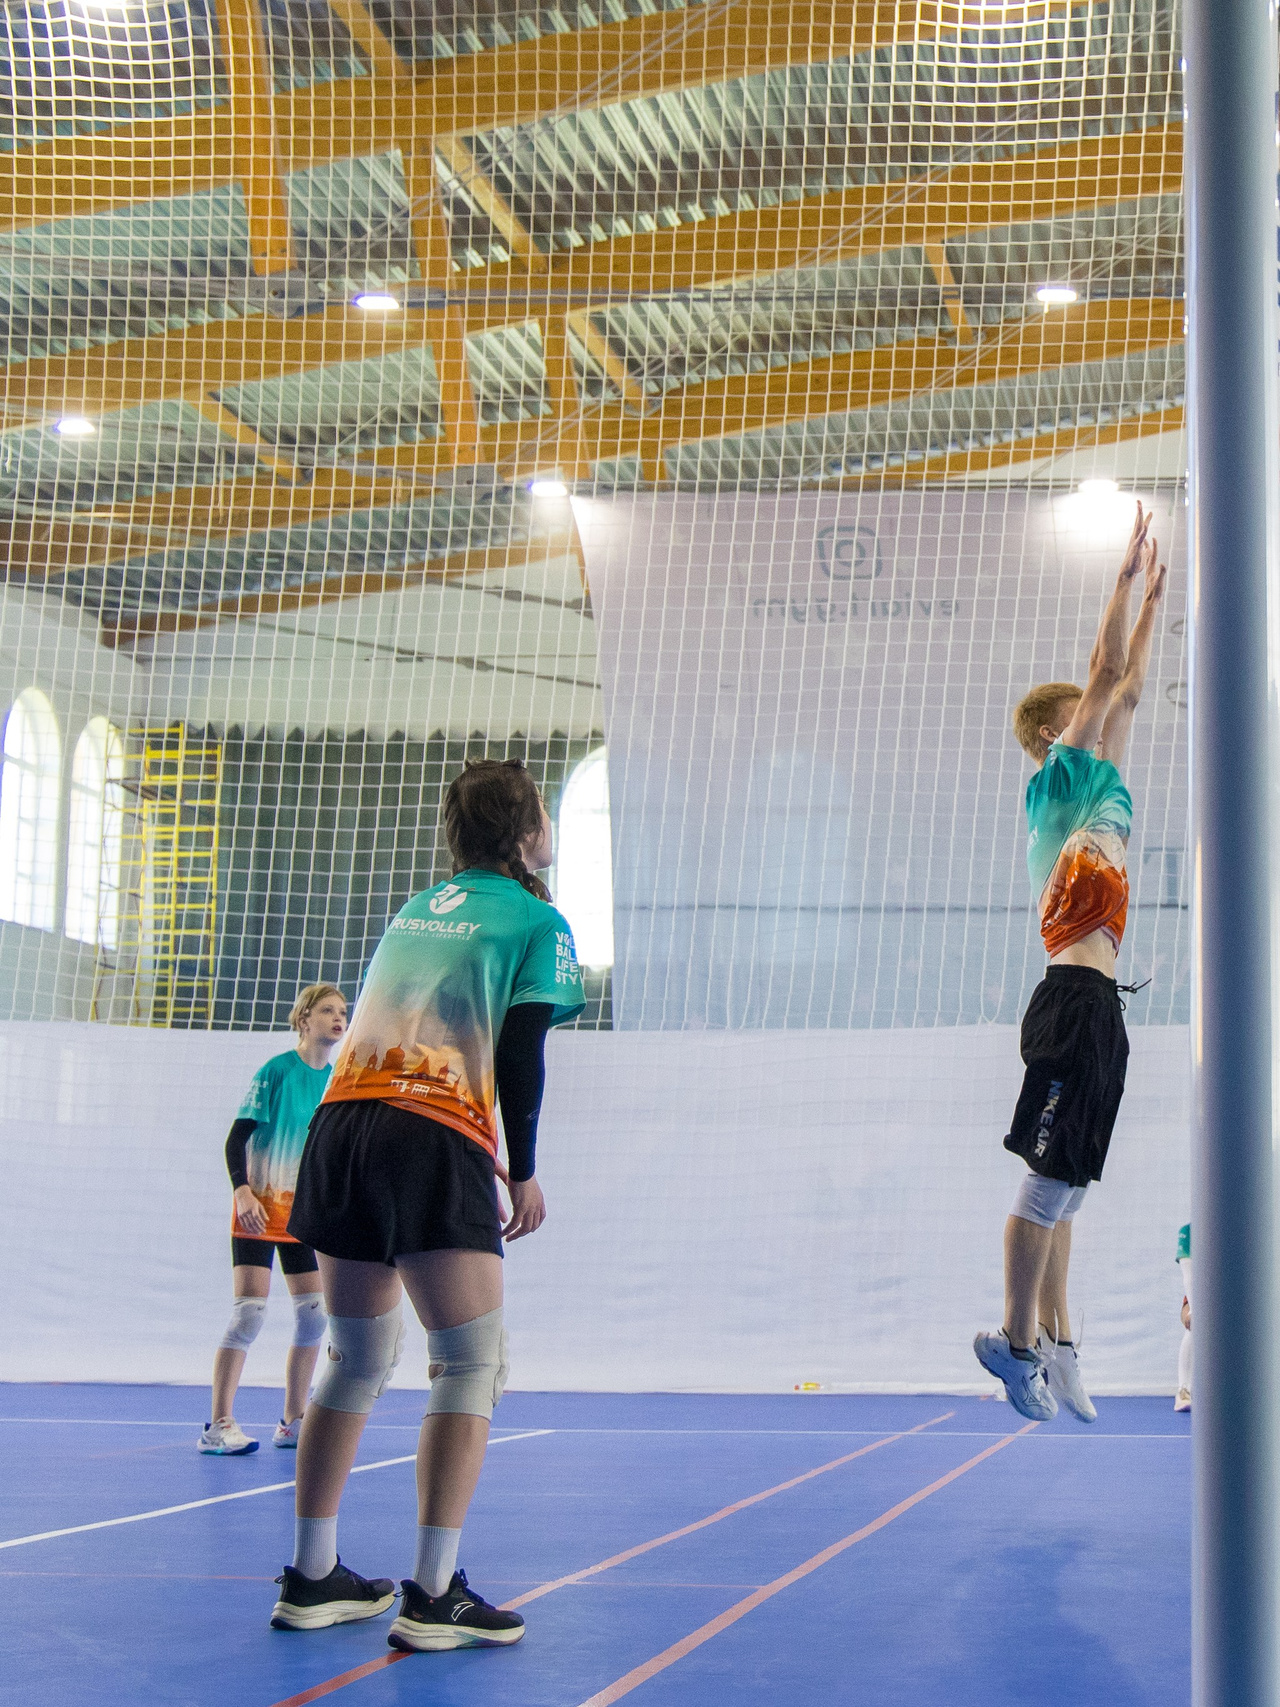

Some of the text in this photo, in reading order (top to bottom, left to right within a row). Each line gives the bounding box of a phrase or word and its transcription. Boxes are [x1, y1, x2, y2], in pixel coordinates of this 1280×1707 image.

[390, 917, 482, 934] RUSVOLLEY
[555, 956, 579, 973] LIFE
[1034, 1080, 1064, 1157] NIKE AIR
